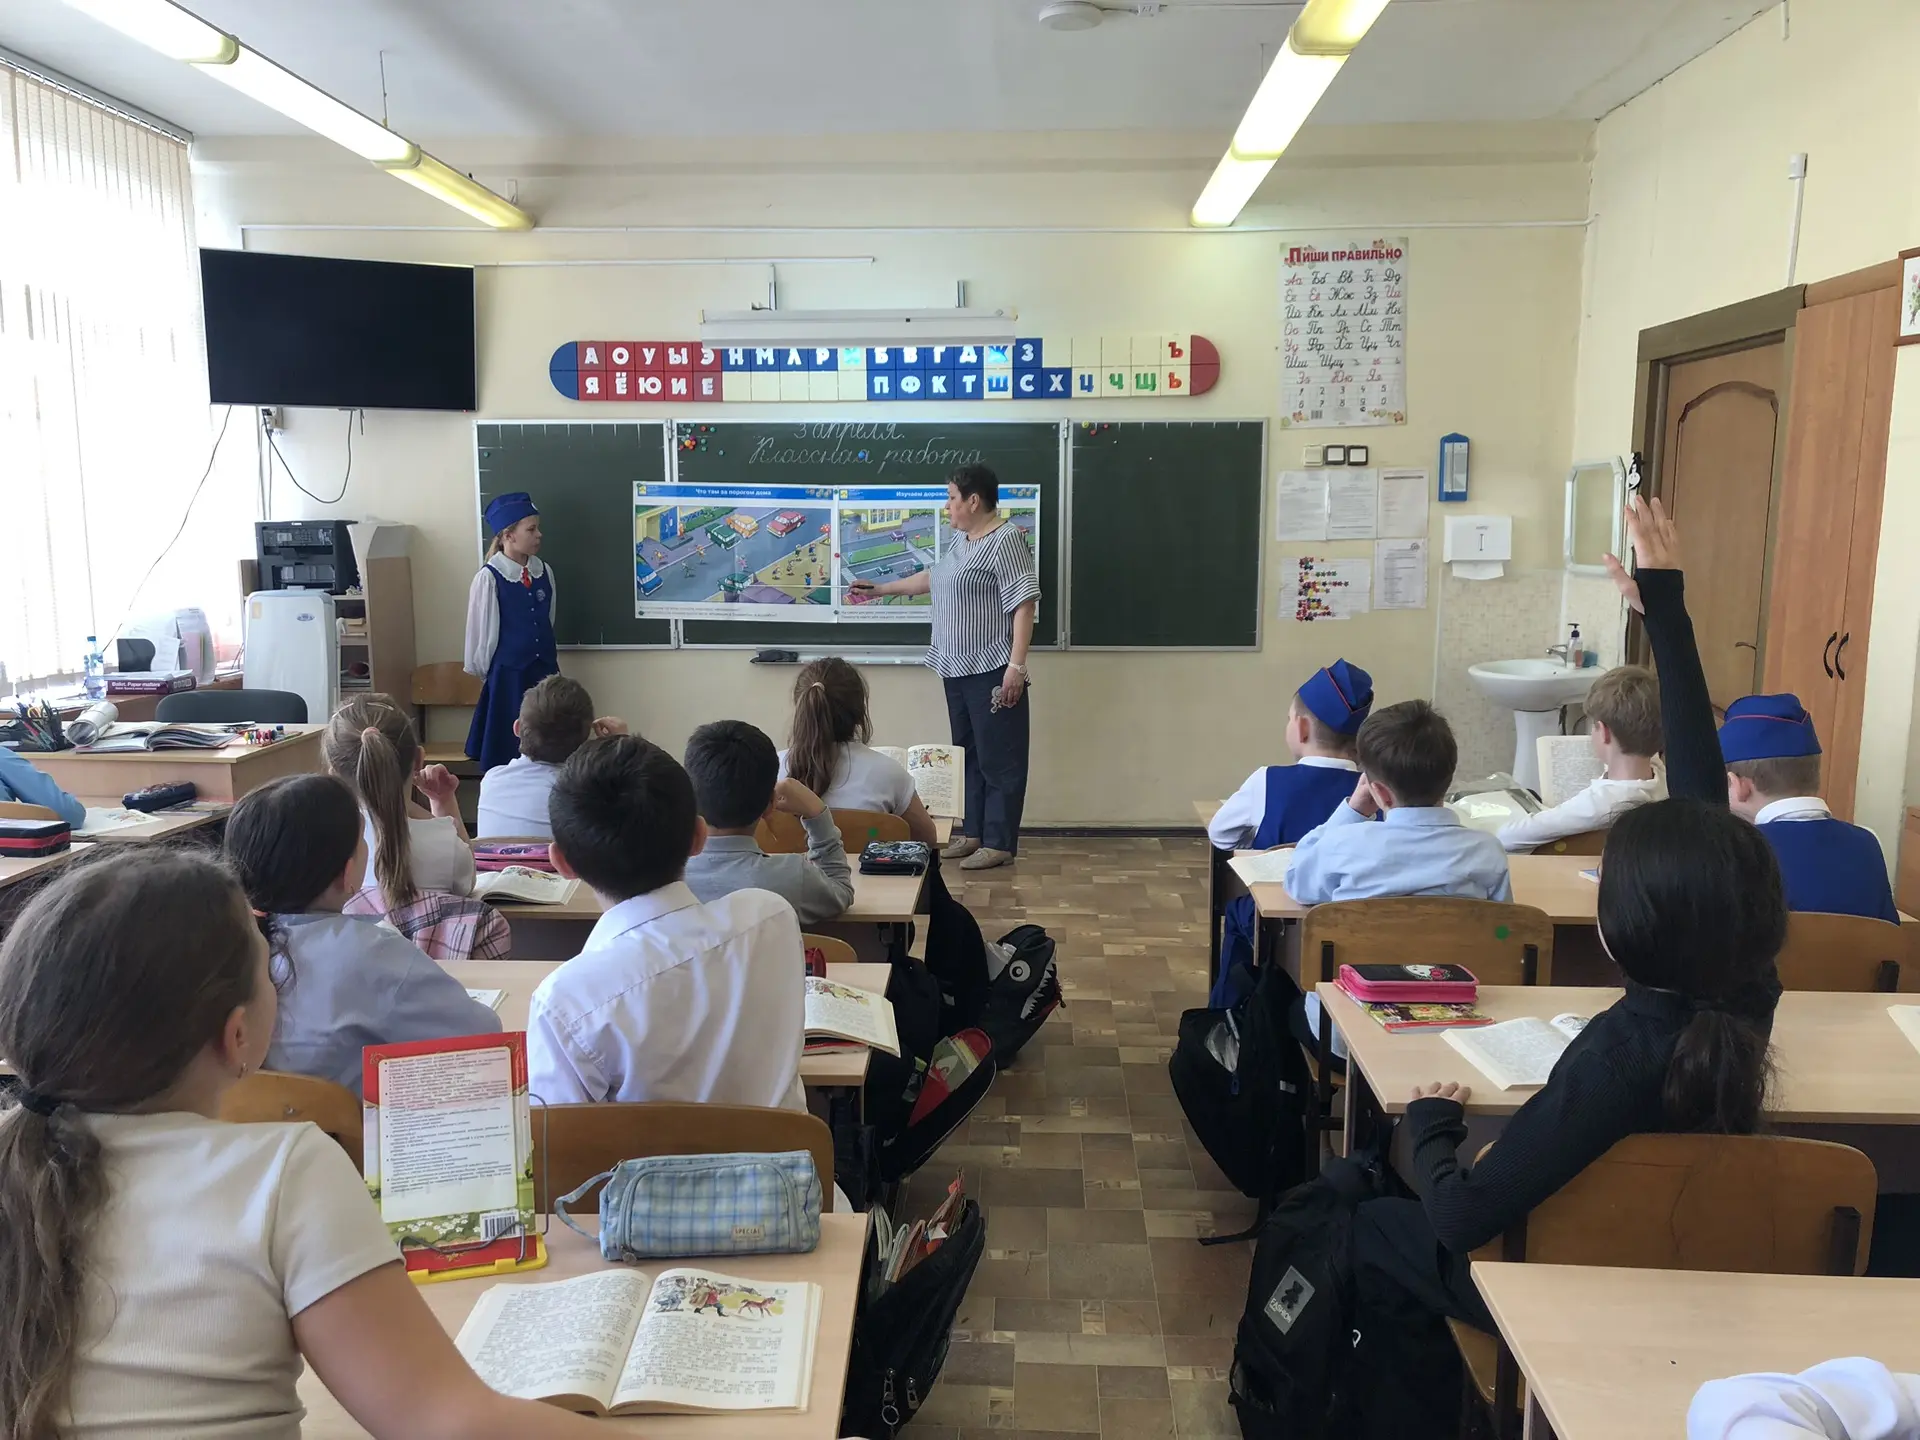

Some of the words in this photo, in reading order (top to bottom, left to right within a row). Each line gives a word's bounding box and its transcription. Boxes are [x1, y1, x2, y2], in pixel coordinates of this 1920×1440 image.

[1332, 248, 1402, 261] ПРАВИЛЬНО
[1337, 270, 1354, 283] Вв
[1383, 268, 1401, 285] Дд
[584, 348, 599, 365] А
[612, 347, 629, 365] О
[643, 348, 656, 365] У
[668, 348, 688, 364] Ы
[700, 348, 714, 365] Э
[729, 348, 743, 365] Н
[756, 348, 774, 365] М
[787, 348, 802, 365] Л
[816, 348, 830, 365] Р
[874, 346, 888, 364] Б
[903, 346, 918, 363] В
[933, 346, 946, 363] Г
[959, 346, 977, 363] Д
[1021, 343, 1034, 362] З
[1168, 342, 1183, 358] Ъ
[585, 377, 599, 394] Я
[615, 372, 627, 394] Ё
[638, 377, 662, 394] Ю
[671, 378, 687, 394] И
[702, 378, 714, 394] Е
[874, 376, 889, 393] П
[901, 376, 921, 393] Ф
[932, 376, 947, 393] К
[962, 375, 976, 393] Т
[988, 376, 1008, 392] Ш
[1020, 374, 1034, 392] С
[1049, 375, 1064, 391] Х
[1079, 374, 1094, 393] Ц
[1109, 373, 1124, 389] Ч
[1135, 373, 1156, 391] Щ
[1168, 372, 1182, 388] Ь
[1298, 400, 1304, 408] 6
[1360, 398, 1366, 406] 9
[877, 436, 986, 474] работа
[1269, 1298, 1291, 1323] FASHION
